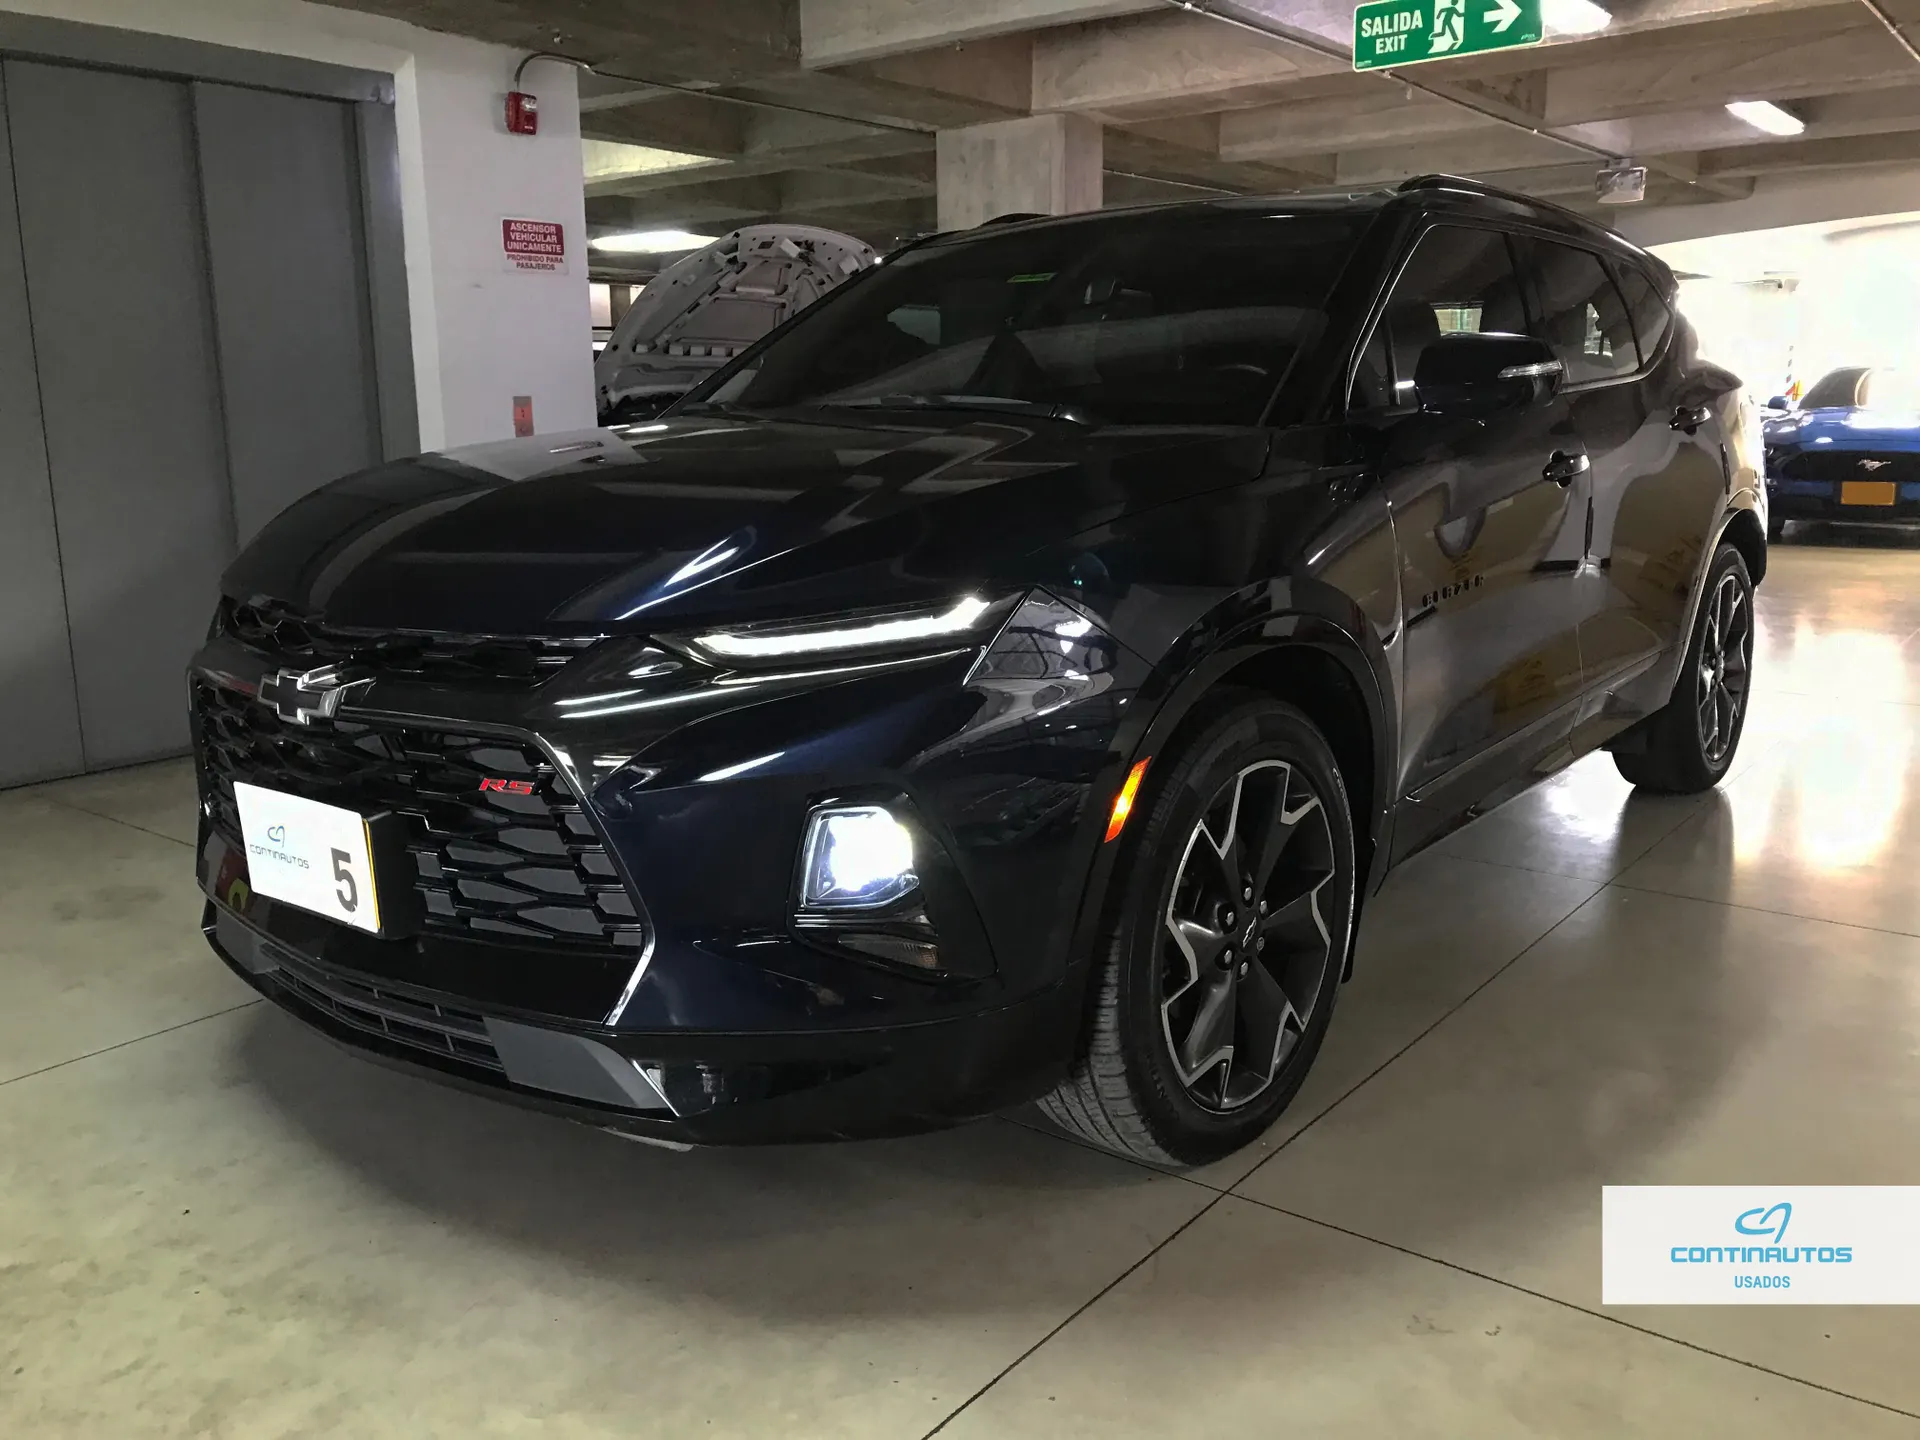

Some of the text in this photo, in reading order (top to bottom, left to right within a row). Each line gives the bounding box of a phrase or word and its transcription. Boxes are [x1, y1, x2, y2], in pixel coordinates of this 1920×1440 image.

[1361, 10, 1423, 37] SALIDA
[1375, 34, 1408, 54] EXIT
[510, 222, 556, 234] ASCENSOR
[510, 231, 557, 243] VEHICULAR
[507, 241, 562, 253] UNICAMENTE
[507, 254, 564, 264] PROHIBIDO PARA
[516, 262, 555, 270] PASAJEROS
[479, 778, 535, 795] RS
[249, 844, 310, 870] CONTINAUTOS
[330, 847, 358, 913] 5
